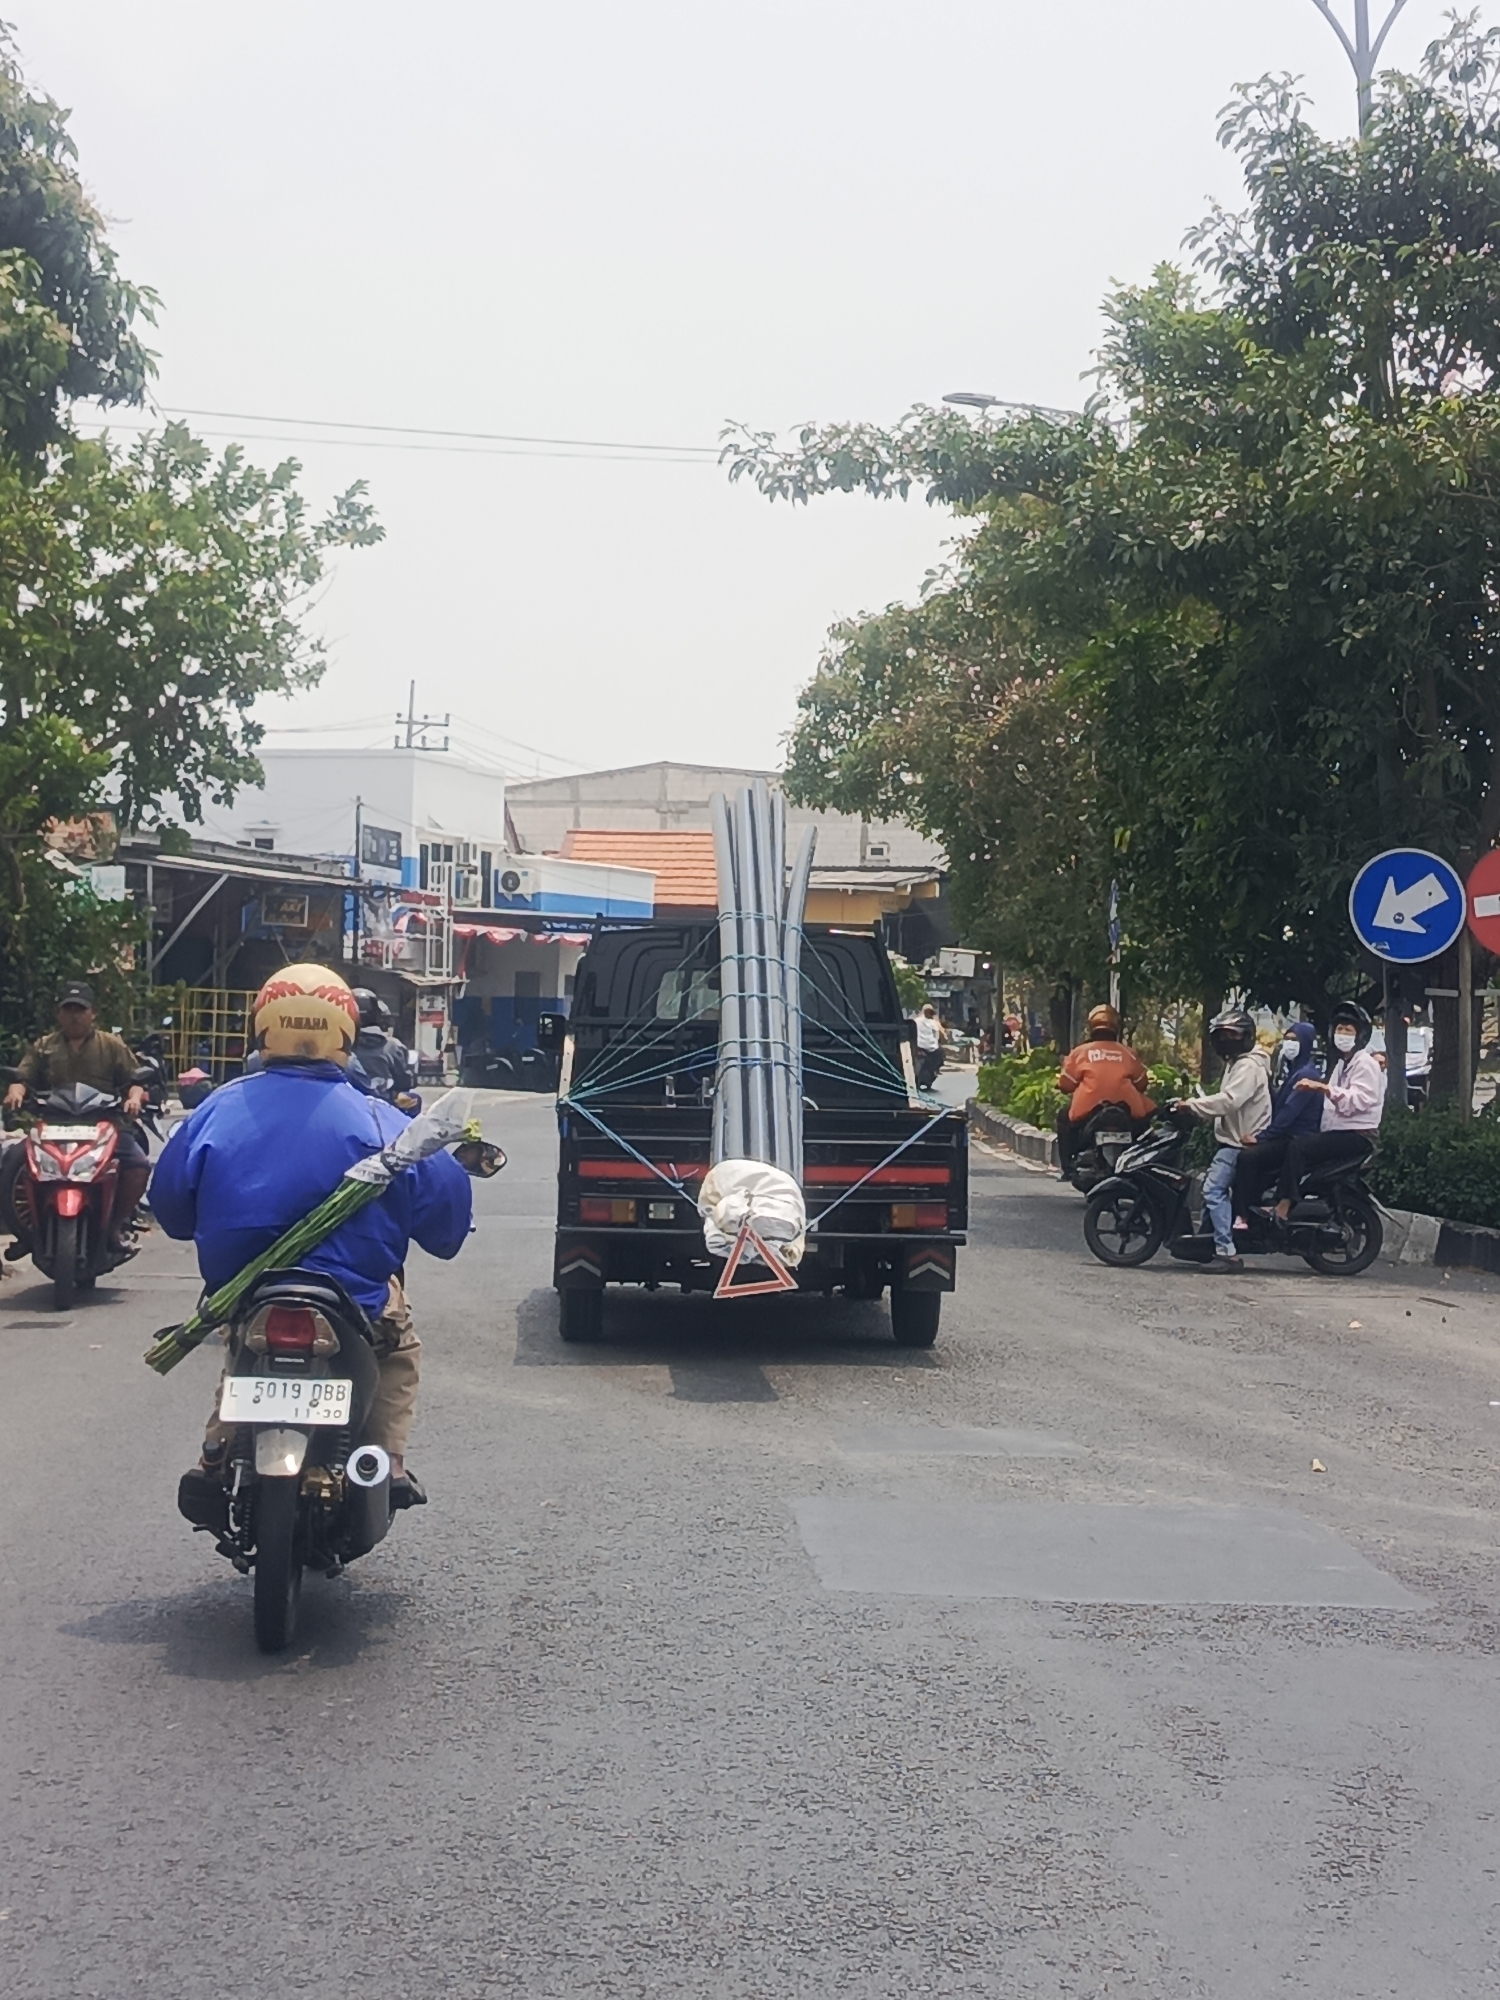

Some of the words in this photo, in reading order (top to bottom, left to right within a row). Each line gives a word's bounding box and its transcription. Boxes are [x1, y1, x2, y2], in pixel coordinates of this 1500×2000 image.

[279, 1015, 328, 1031] YAMAHA
[229, 1382, 238, 1398] L
[254, 1382, 301, 1399] 5019
